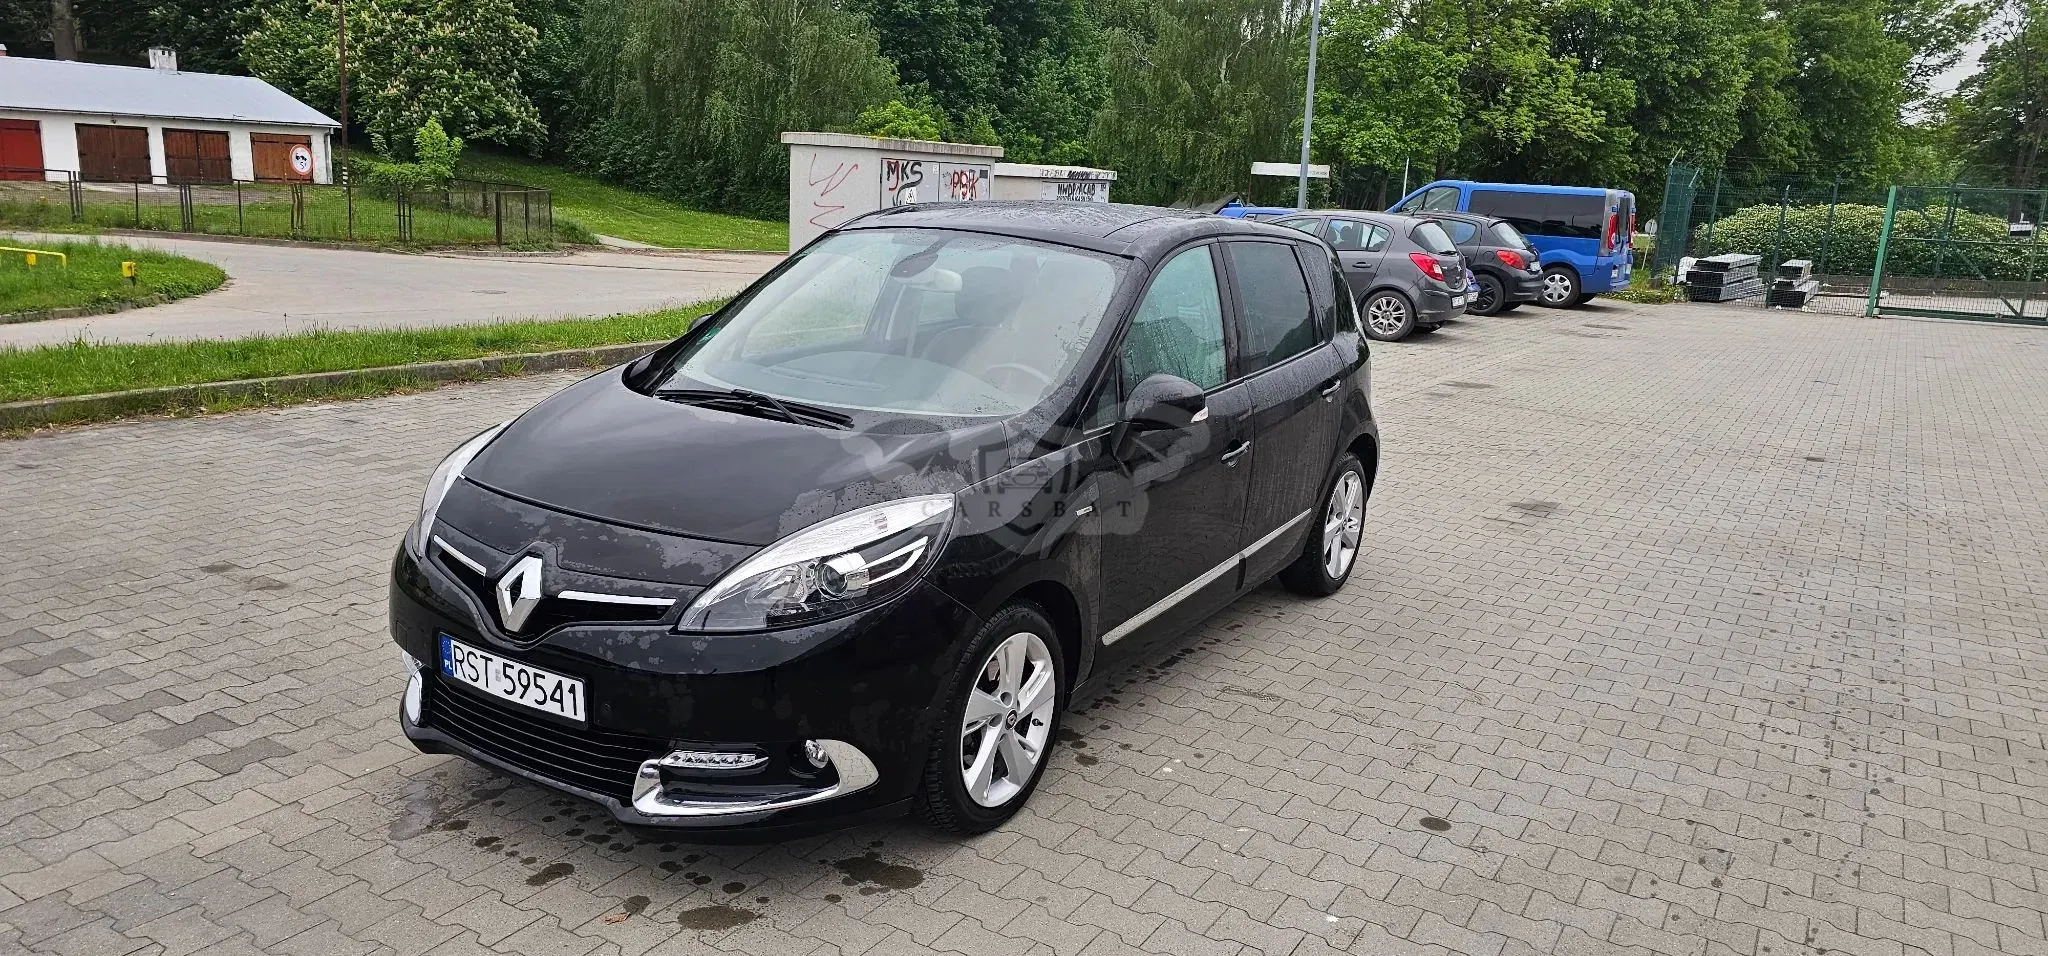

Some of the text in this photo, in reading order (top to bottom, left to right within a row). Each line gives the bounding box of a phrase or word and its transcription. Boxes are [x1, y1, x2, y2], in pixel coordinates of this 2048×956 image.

[444, 659, 453, 670] PL
[453, 644, 578, 716] RST 59541
